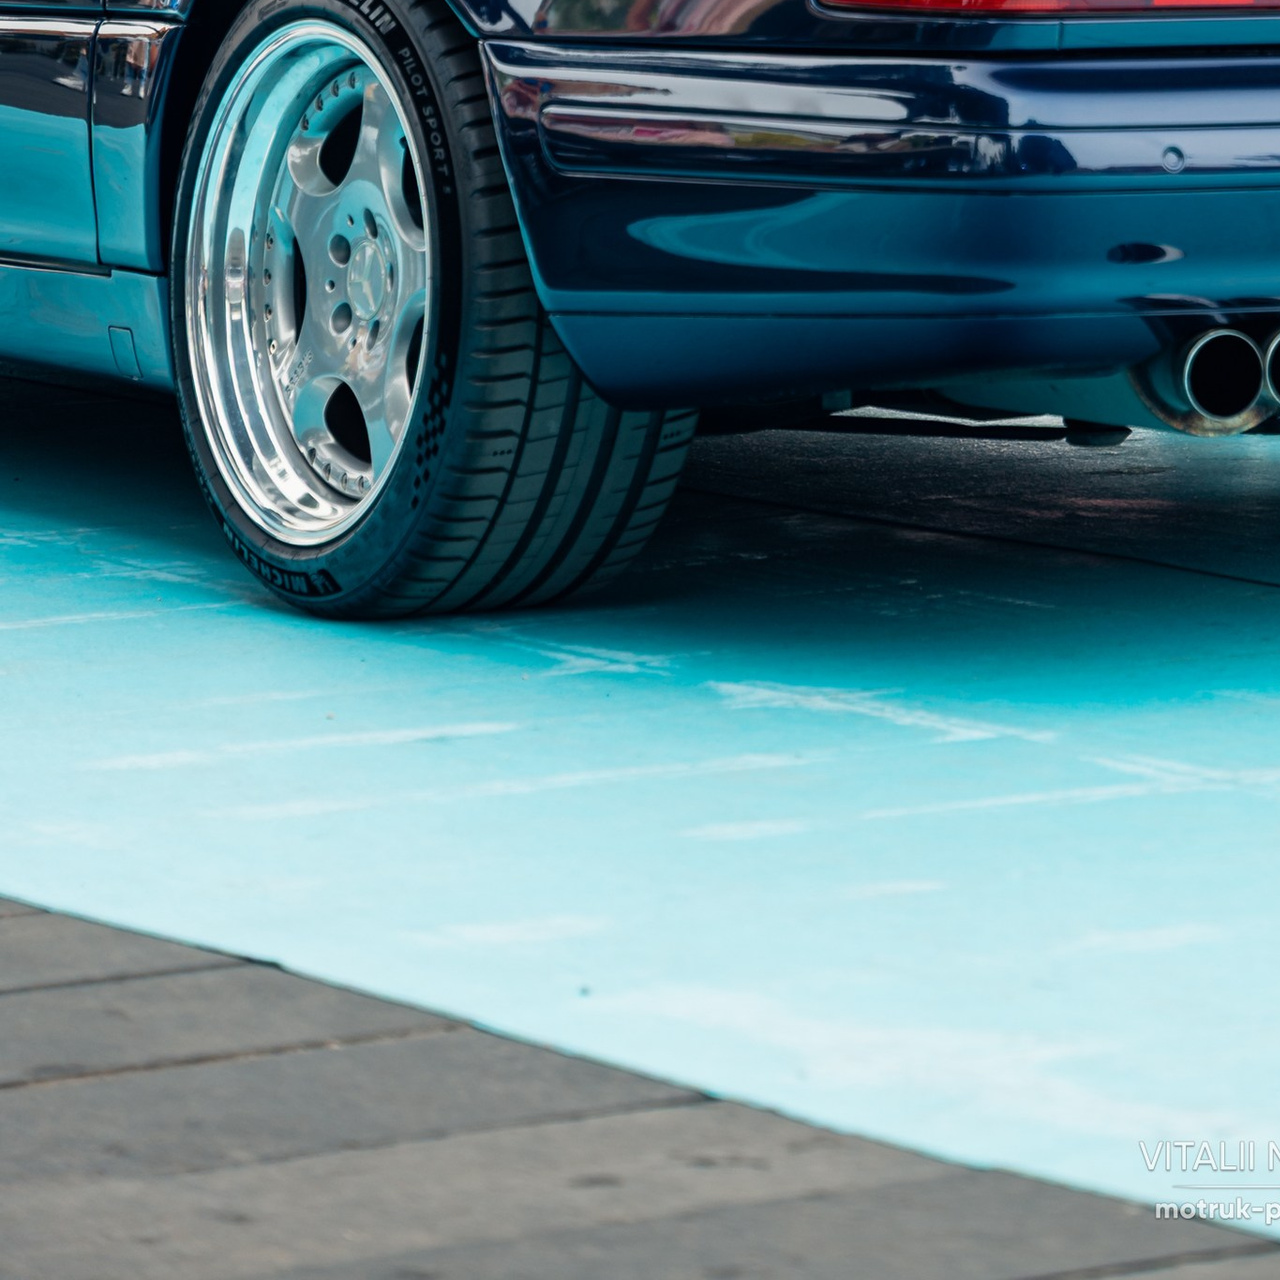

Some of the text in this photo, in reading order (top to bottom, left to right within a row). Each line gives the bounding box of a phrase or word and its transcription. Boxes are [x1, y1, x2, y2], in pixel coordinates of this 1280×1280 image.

[398, 47, 449, 178] PILOT SPORT
[223, 522, 308, 594] MICHELIN
